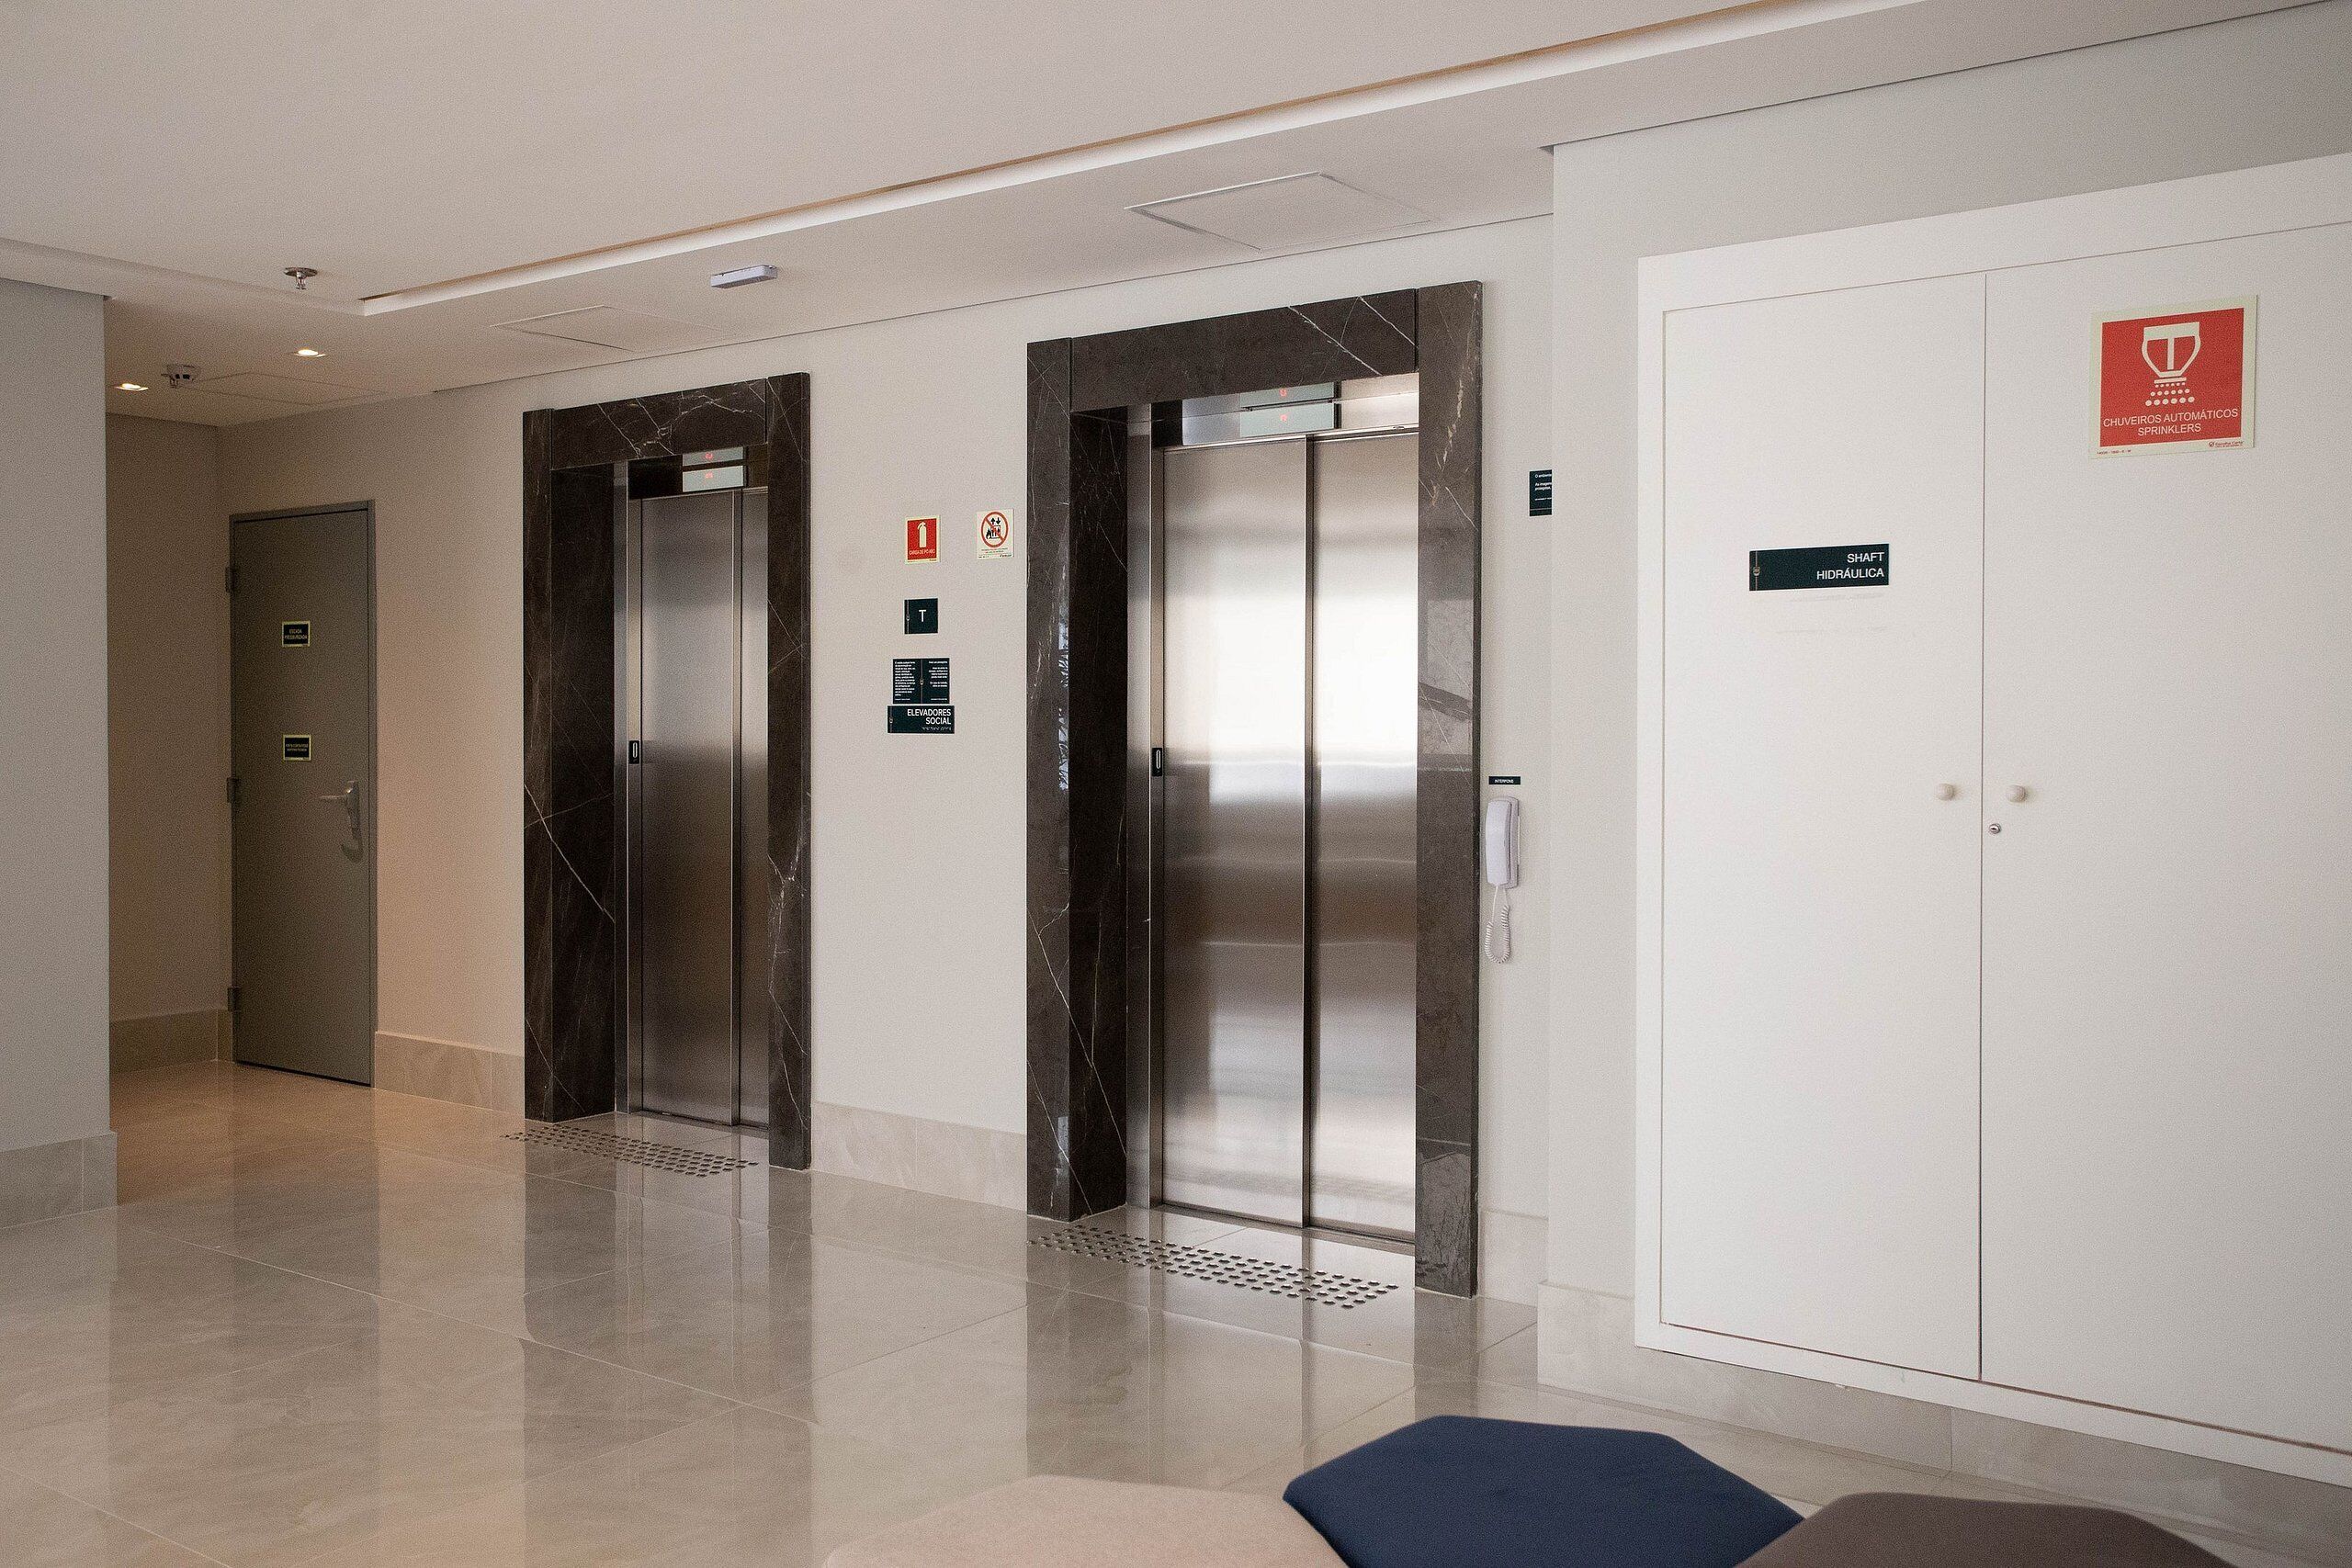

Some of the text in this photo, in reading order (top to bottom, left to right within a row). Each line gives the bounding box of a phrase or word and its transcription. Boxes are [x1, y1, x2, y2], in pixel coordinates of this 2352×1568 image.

[2103, 408, 2239, 427] CHUVEIROS AUTOMÁTICOS
[2137, 423, 2201, 436] SPRINKLERS
[1847, 552, 1884, 563] SHAFT
[1816, 567, 1884, 580] HIDRÁULICA
[918, 609, 926, 622] T
[907, 708, 952, 716] ELEVADORES
[925, 716, 952, 725] SOCIAL
